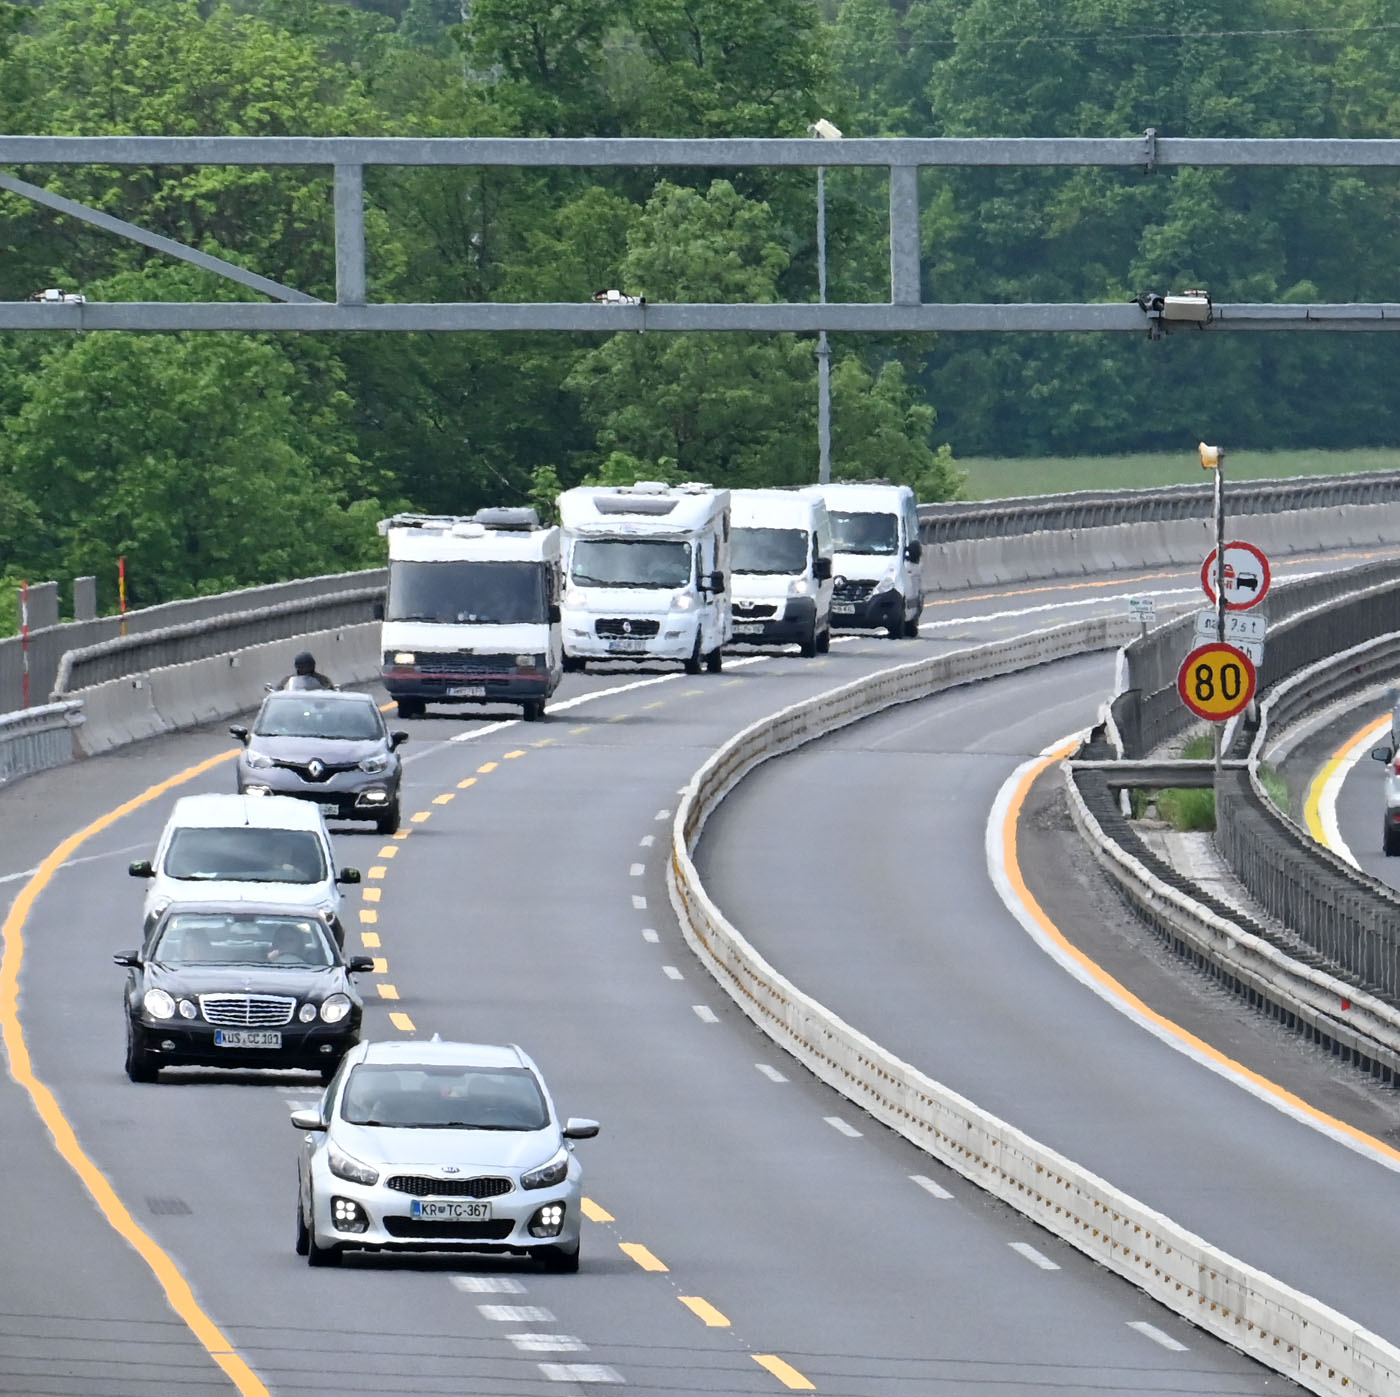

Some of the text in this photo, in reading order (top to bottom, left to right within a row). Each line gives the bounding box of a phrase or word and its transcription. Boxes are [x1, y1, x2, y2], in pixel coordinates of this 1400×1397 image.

[1195, 663, 1241, 701] 80
[422, 1204, 488, 1217] KR TC-367
